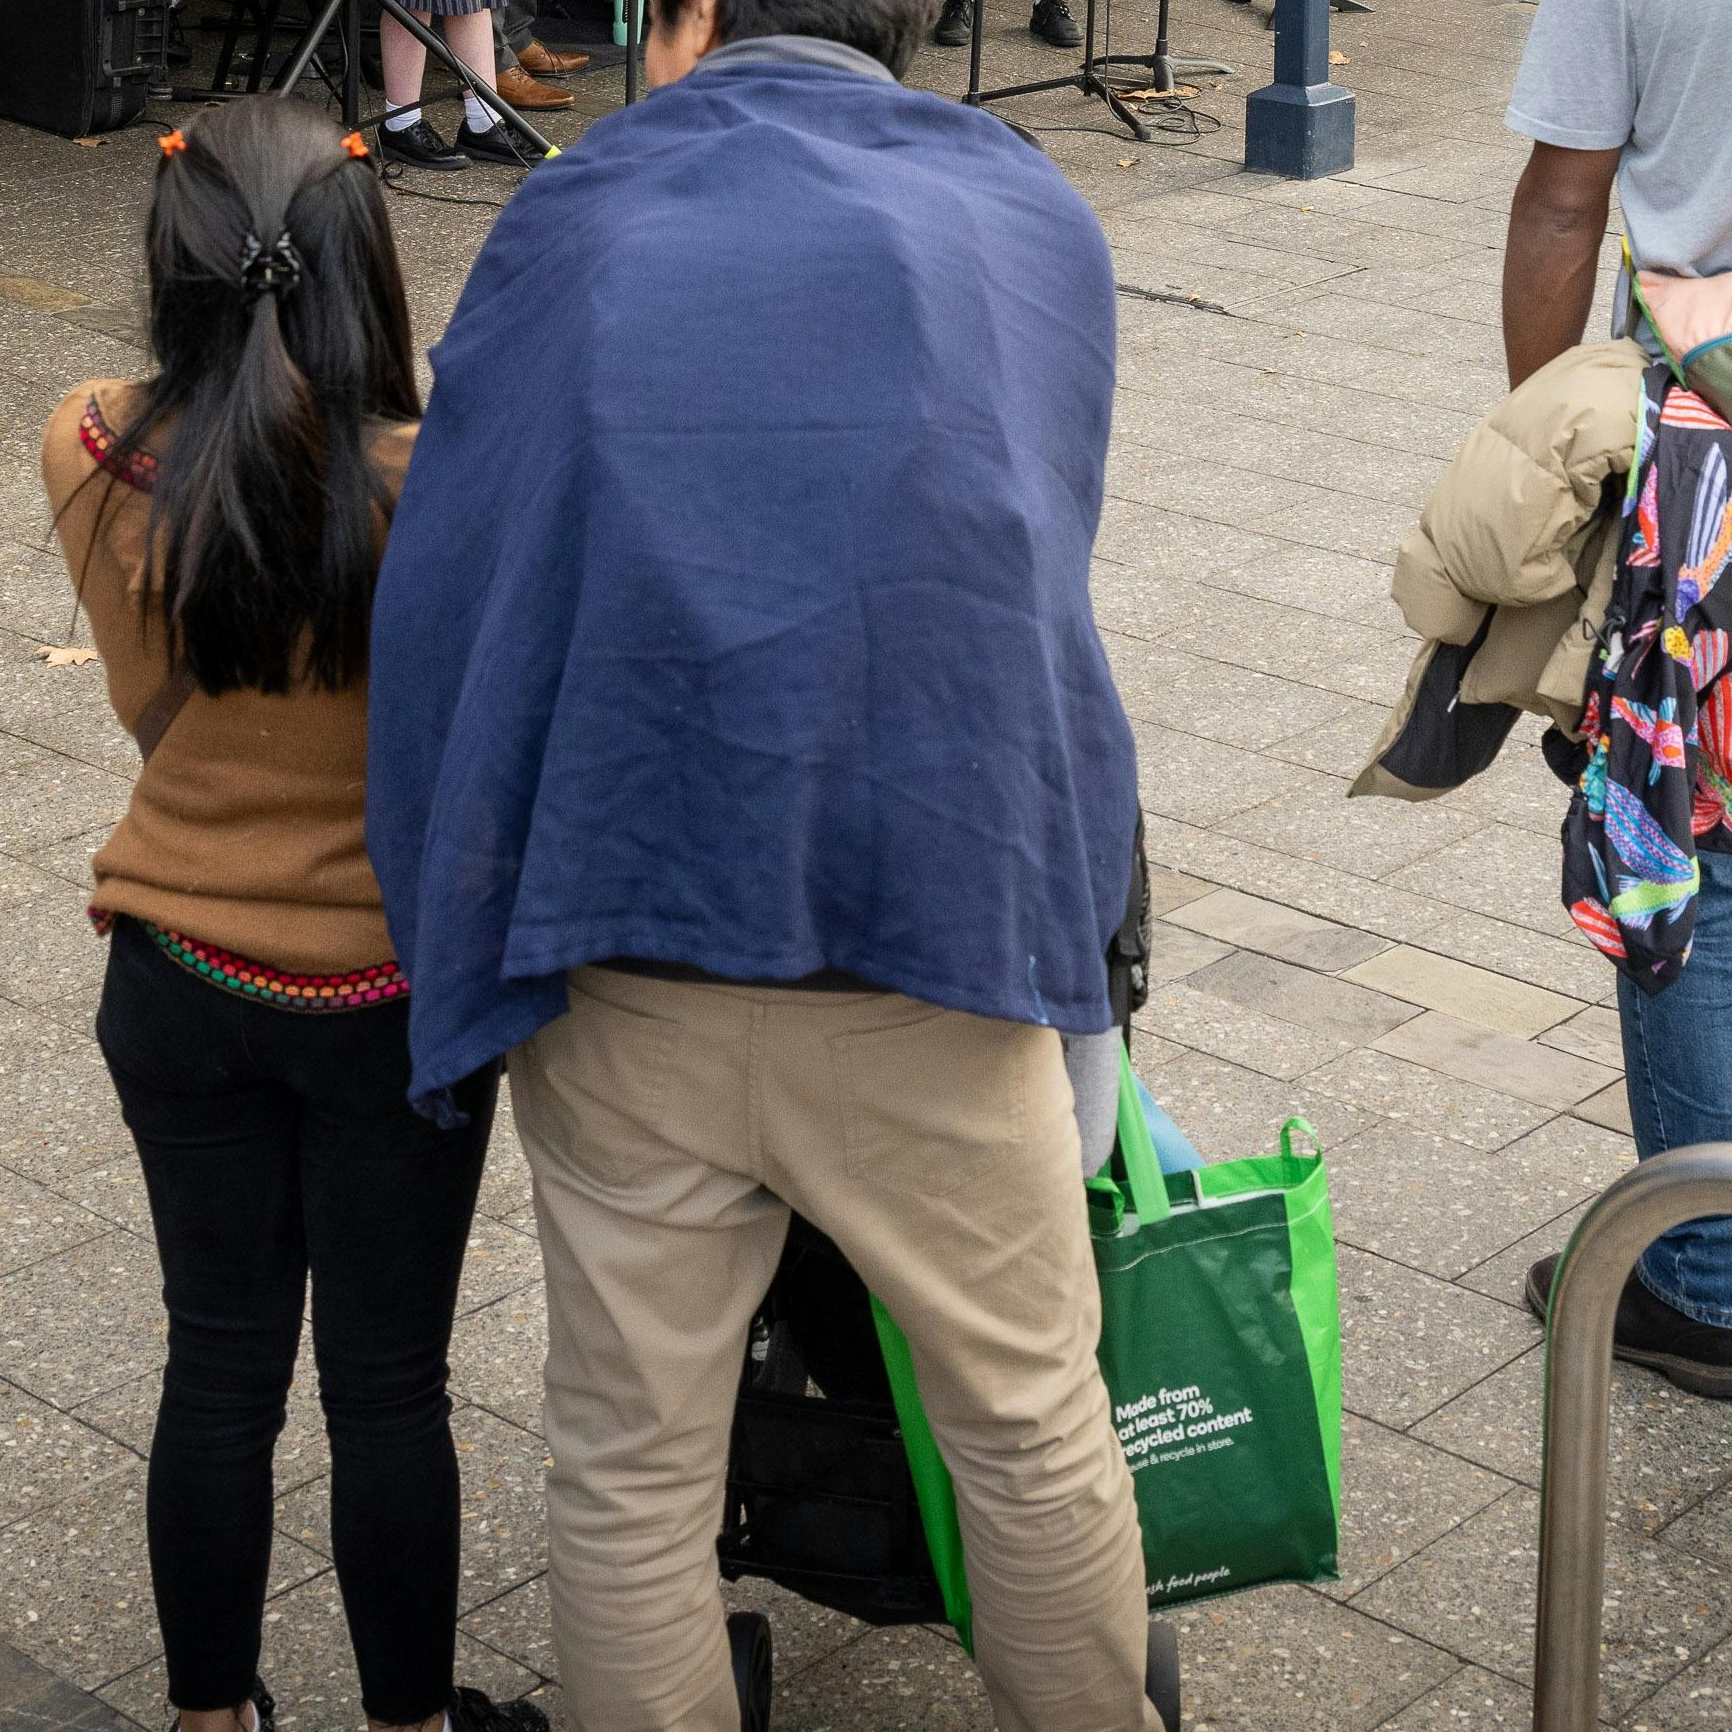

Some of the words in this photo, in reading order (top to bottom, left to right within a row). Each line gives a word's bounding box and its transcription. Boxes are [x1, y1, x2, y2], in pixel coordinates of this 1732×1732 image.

[1115, 1394, 1157, 1423] Made
[1158, 1385, 1201, 1406] from
[1118, 1422, 1136, 1441] at
[1135, 1407, 1176, 1433] least
[1176, 1397, 1214, 1421] 70%
[1187, 1407, 1253, 1438] content
[1193, 1565, 1230, 1587] people
